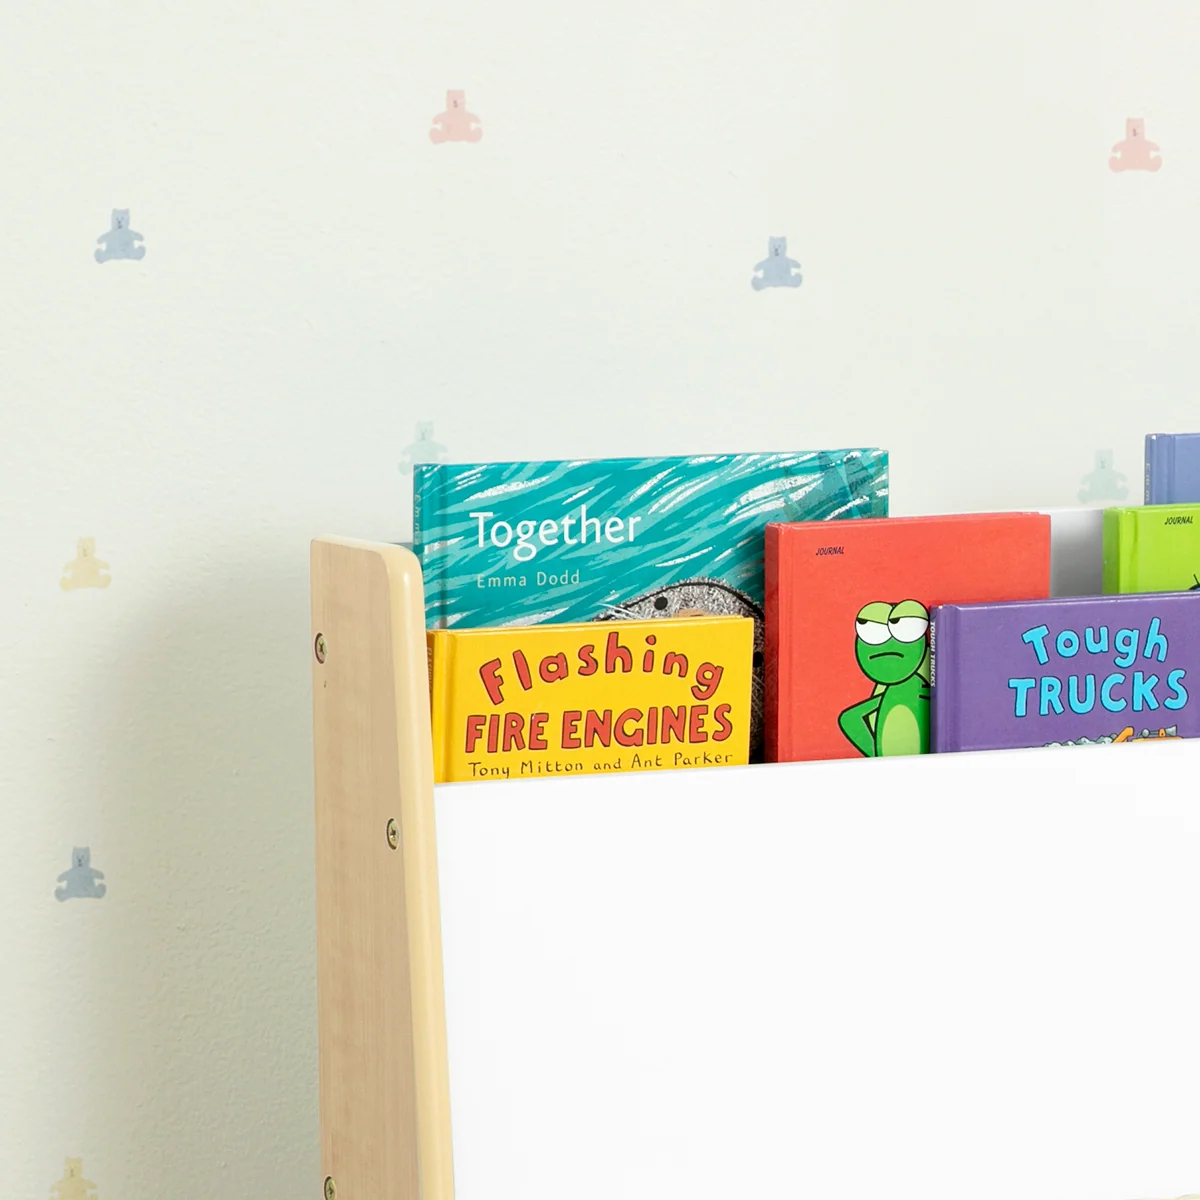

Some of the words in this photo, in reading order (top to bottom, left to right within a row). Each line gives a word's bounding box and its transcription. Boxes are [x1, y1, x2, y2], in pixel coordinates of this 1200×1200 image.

[469, 504, 642, 562] Together
[1164, 516, 1194, 525] JOURNAL
[815, 546, 845, 556] JOURNAL
[476, 573, 527, 589] Emma
[536, 569, 580, 586] Dodd
[1021, 617, 1168, 668] Tough
[478, 631, 725, 706] Flashing
[1007, 668, 1190, 718] TRUCKS
[465, 712, 549, 753] FIRE
[561, 703, 733, 749] ENGINES
[468, 762, 510, 779] Tony
[520, 759, 583, 775] Mitton
[593, 758, 622, 771] and
[631, 753, 663, 769] Ant
[674, 752, 734, 767] Parker
